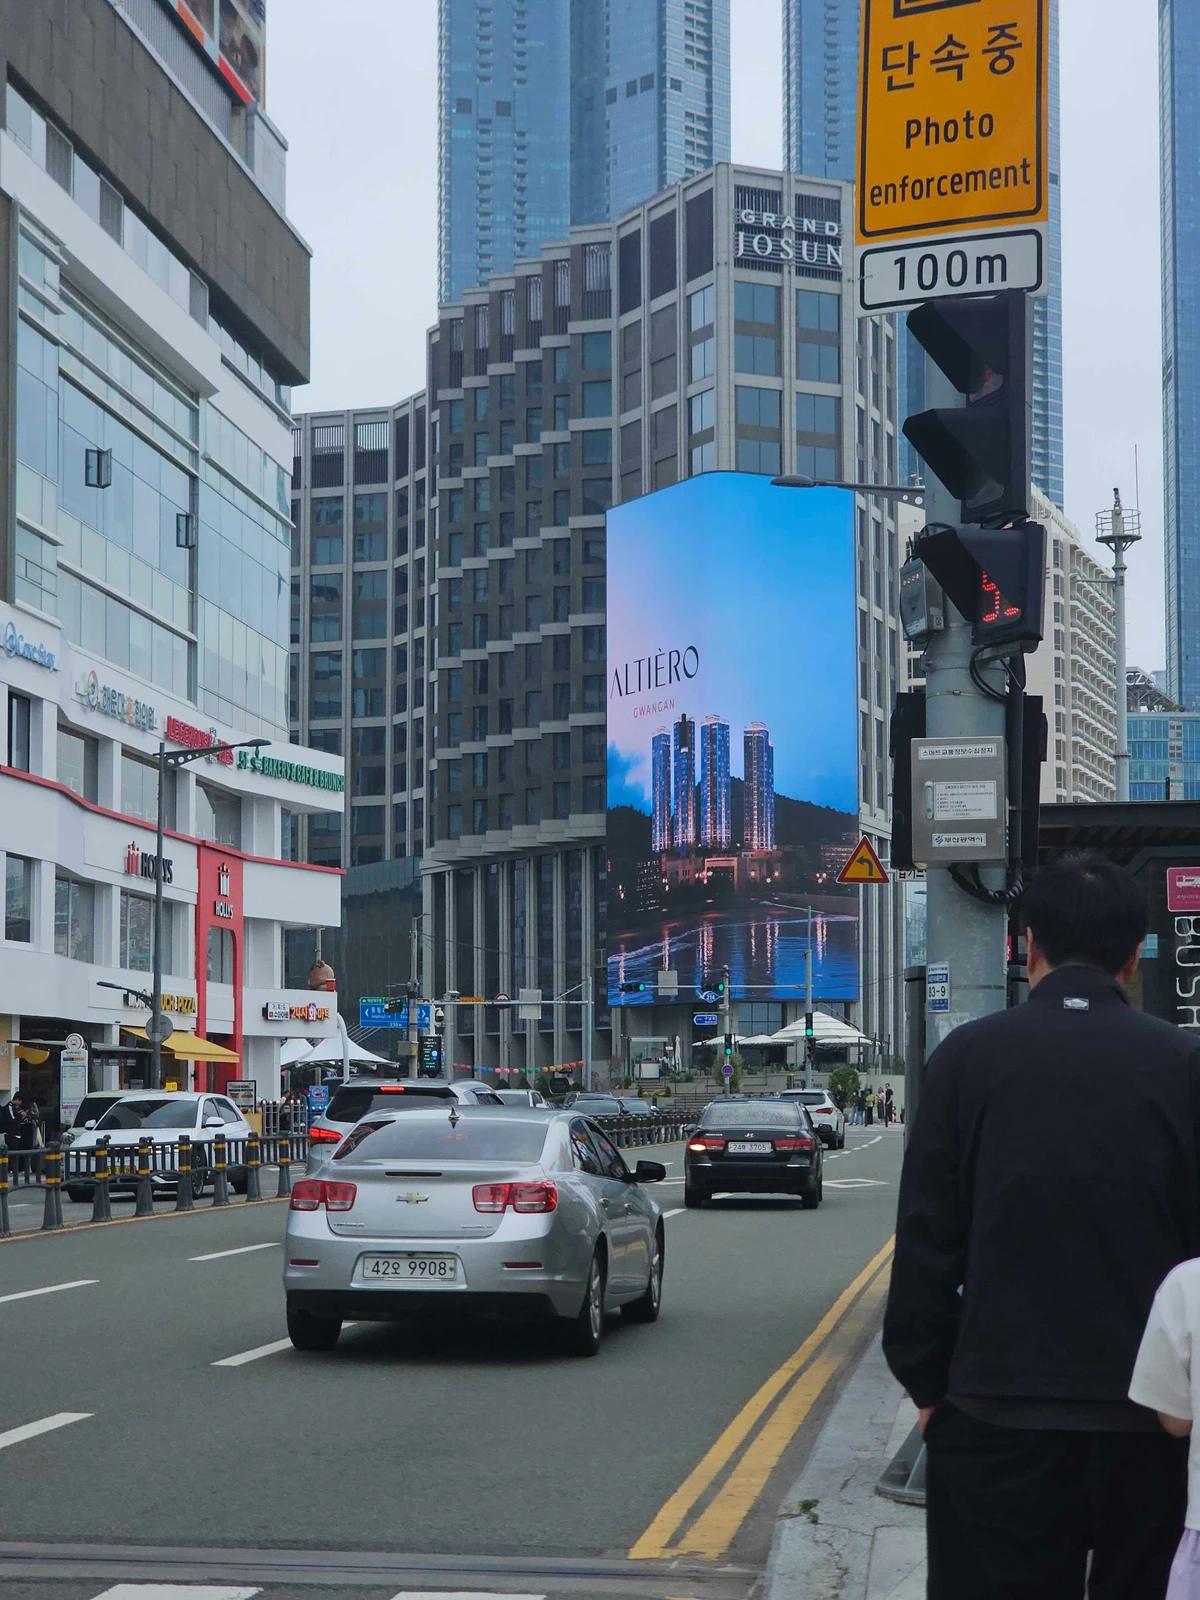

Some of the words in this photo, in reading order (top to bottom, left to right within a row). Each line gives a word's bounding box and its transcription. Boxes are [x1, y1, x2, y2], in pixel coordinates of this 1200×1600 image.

[881, 22, 1023, 92] 단속중
[905, 110, 994, 149] Photo
[869, 158, 1031, 207] enforcement
[741, 208, 839, 236] GRAND
[736, 231, 843, 267] JOSUN
[893, 250, 1008, 291] 100m
[610, 645, 700, 699] ALTIÈRO
[633, 699, 675, 719] GWANGAN
[214, 900, 233, 919] HOLLYS
[178, 996, 196, 1013] PIZZA
[371, 1260, 400, 1275] 42오
[408, 1261, 447, 1276] 9908
